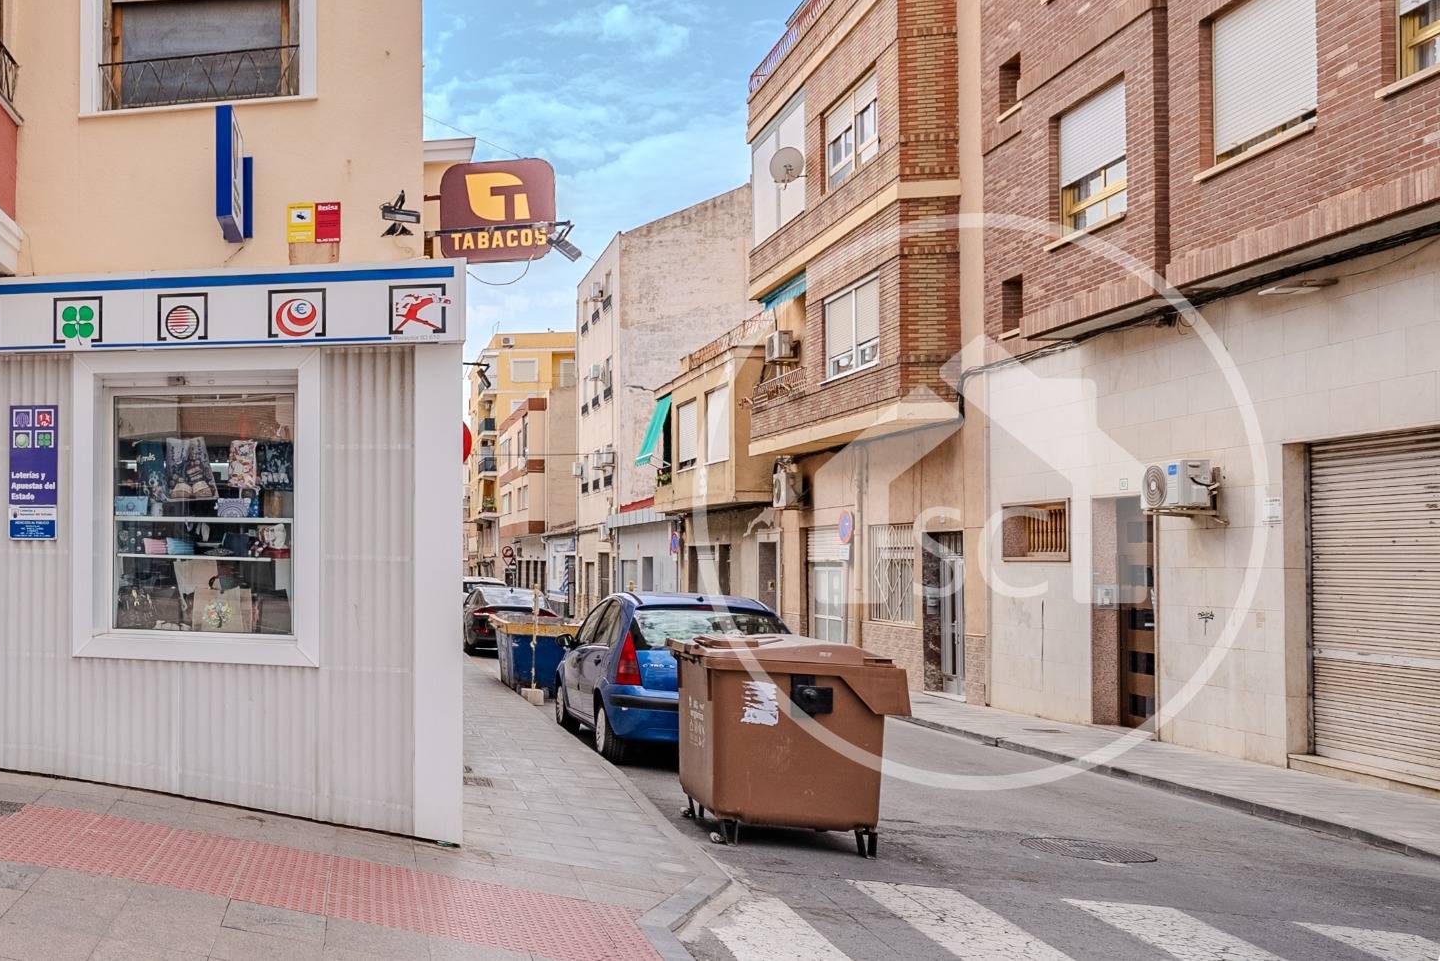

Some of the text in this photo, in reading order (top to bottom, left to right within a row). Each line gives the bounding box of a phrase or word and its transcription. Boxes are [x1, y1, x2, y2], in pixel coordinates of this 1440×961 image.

[450, 228, 547, 251] TABACOS
[11, 471, 46, 480] Loterías y
[11, 481, 56, 491] Apuestas del
[11, 492, 35, 500] Estado
